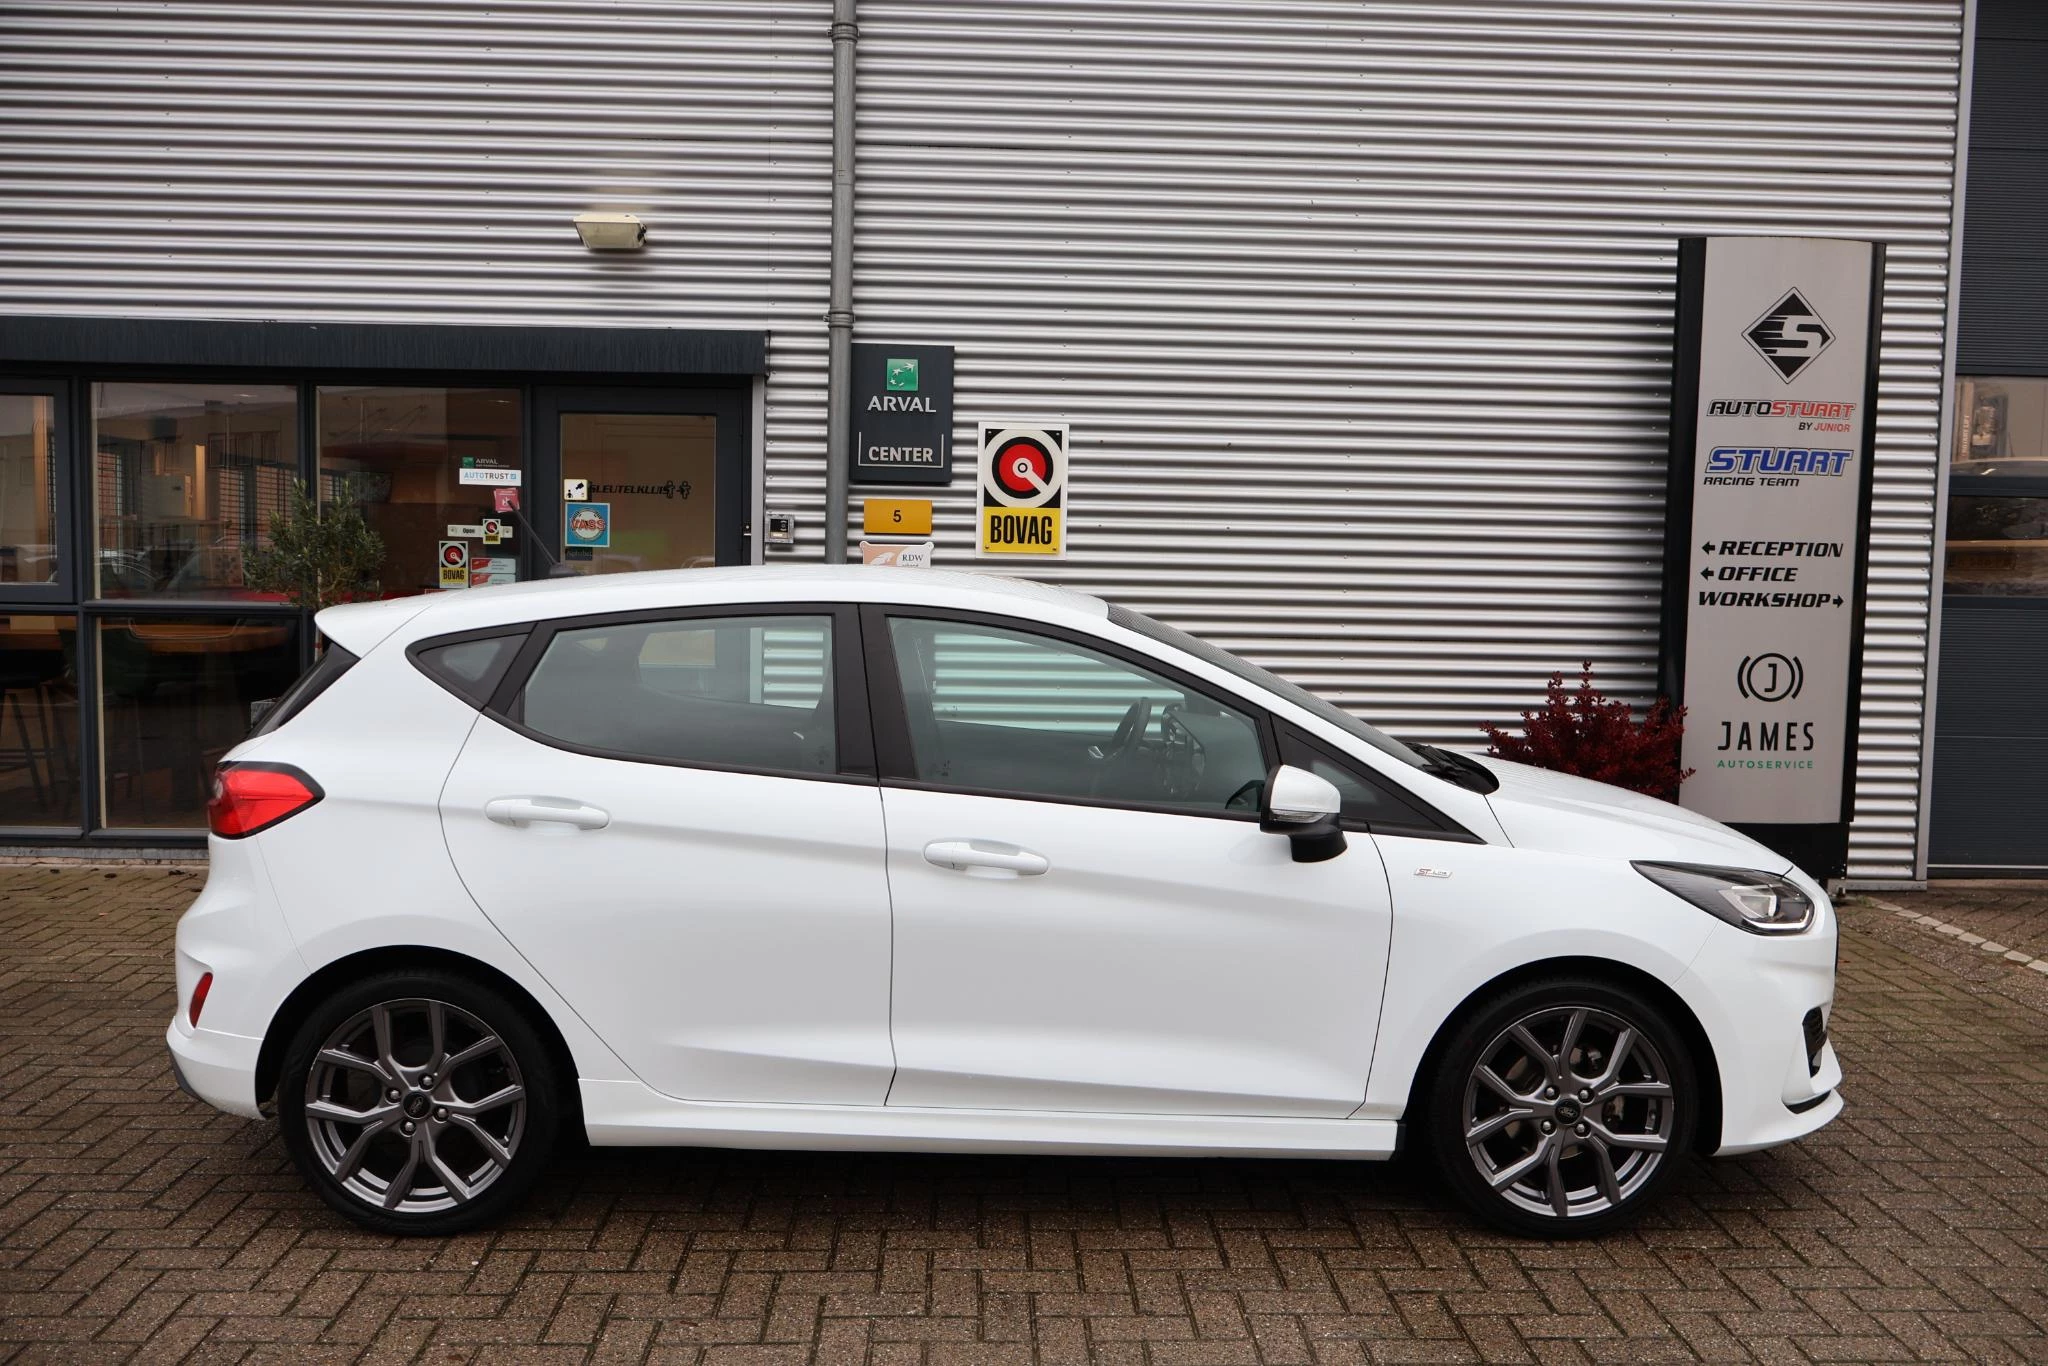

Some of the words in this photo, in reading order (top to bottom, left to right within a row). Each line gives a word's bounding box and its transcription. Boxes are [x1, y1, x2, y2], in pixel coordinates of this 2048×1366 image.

[867, 396, 937, 413] ARVAL
[1706, 399, 1856, 420] AUTOSTUART
[1798, 422, 1813, 431] BY
[1813, 423, 1851, 432] JUNIOR
[868, 446, 933, 463] CENTER
[1704, 446, 1855, 477] STUART
[464, 471, 509, 480] AUTOTRUST
[1703, 477, 1755, 486] RACING
[1759, 477, 1800, 487] TEAM
[892, 509, 902, 523] 5
[571, 518, 606, 531] VASS
[990, 515, 1053, 545] BOVAG
[1718, 541, 1844, 557] RECEPTION
[902, 553, 924, 562] RDW
[443, 569, 465, 580] BOVAG
[1718, 566, 1799, 582] OFFICE
[1698, 591, 1831, 608] WORKSHOP
[1717, 721, 1814, 751] JAMES
[1717, 759, 1814, 769] AUTOSERVICE
